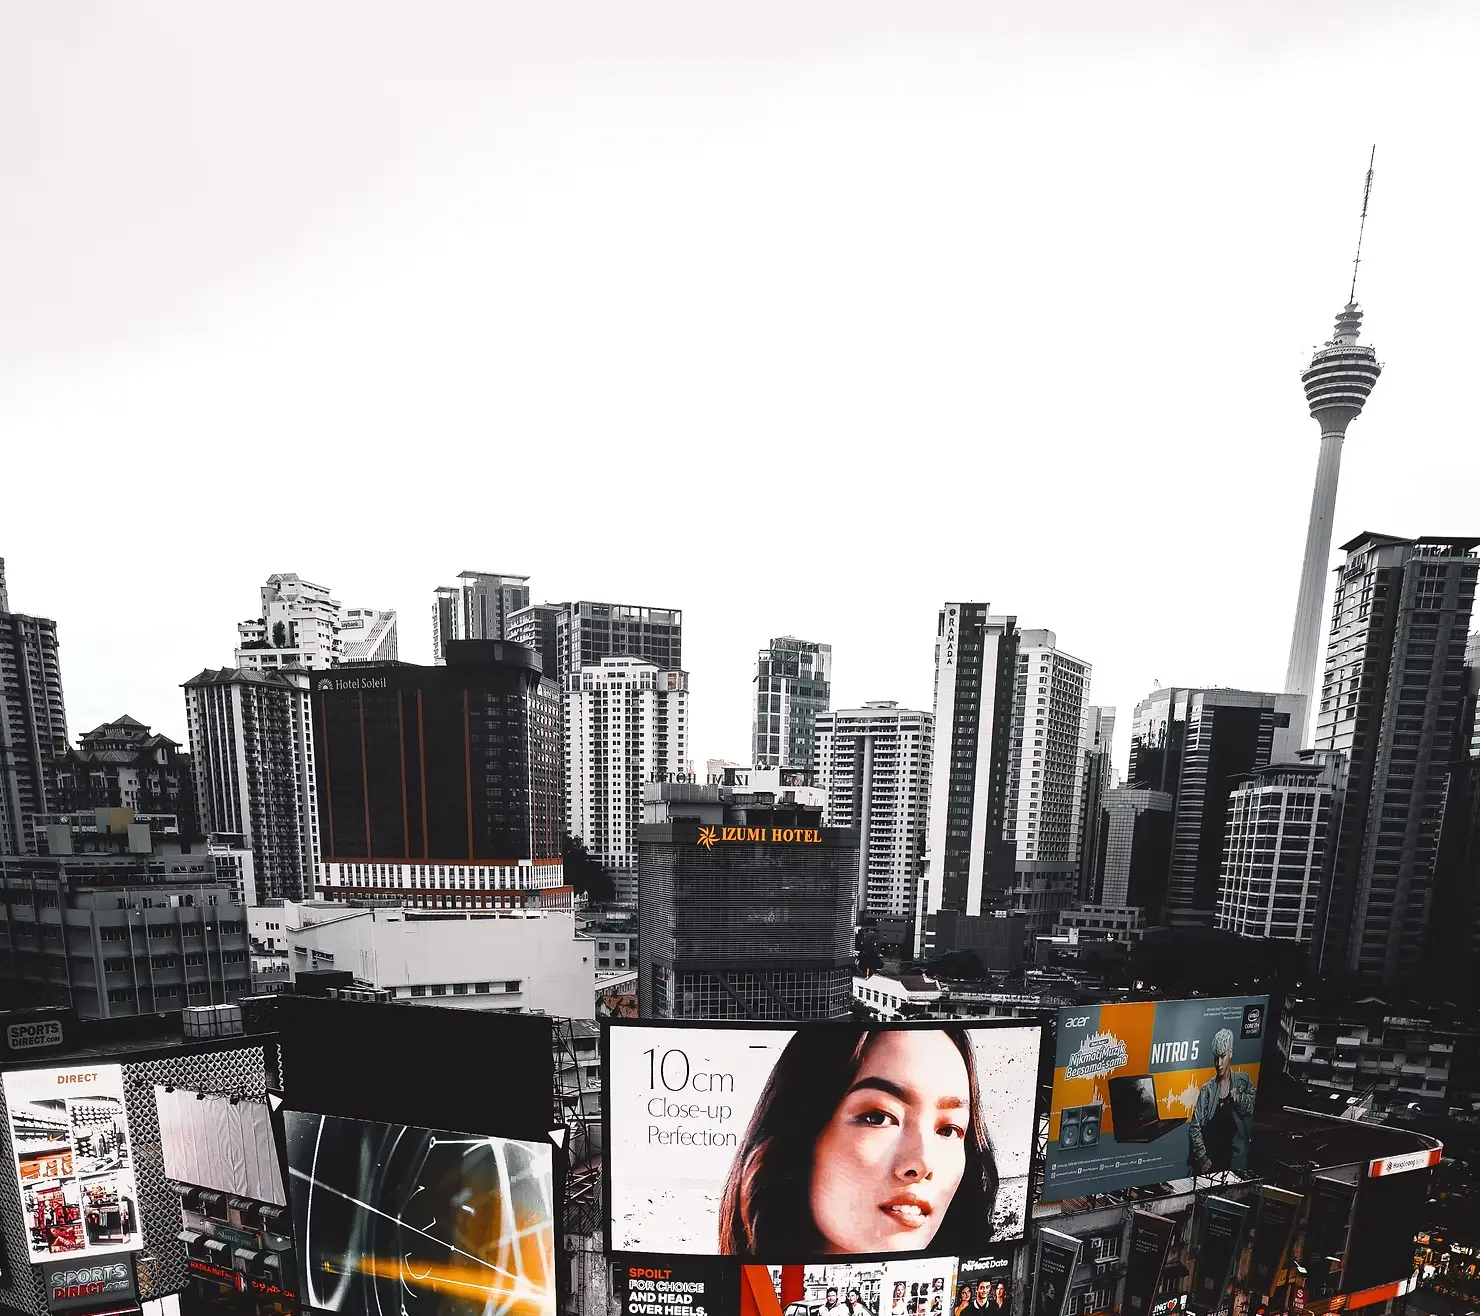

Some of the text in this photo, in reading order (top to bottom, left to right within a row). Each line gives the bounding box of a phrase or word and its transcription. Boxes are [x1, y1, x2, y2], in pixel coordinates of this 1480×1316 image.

[947, 617, 955, 665] RAMADA
[336, 677, 387, 690] Hotel Soleil
[721, 827, 822, 843] IZUMI HOTEL
[10, 1022, 60, 1038] SPORTS
[1065, 1016, 1090, 1028] acer
[1151, 1040, 1200, 1065] NITRO 5
[57, 1073, 98, 1085] DIRECT
[647, 1097, 732, 1123] Close-up
[648, 1125, 737, 1147] Perfection
[51, 1263, 128, 1287] SPORTS
[629, 1267, 672, 1279] SPOILT
[53, 1280, 130, 1300] DIRECT.COM
[629, 1279, 704, 1293] FOR CHOICE
[629, 1292, 693, 1304] AND HEAD
[628, 1303, 708, 1316] OVER HEELS.
